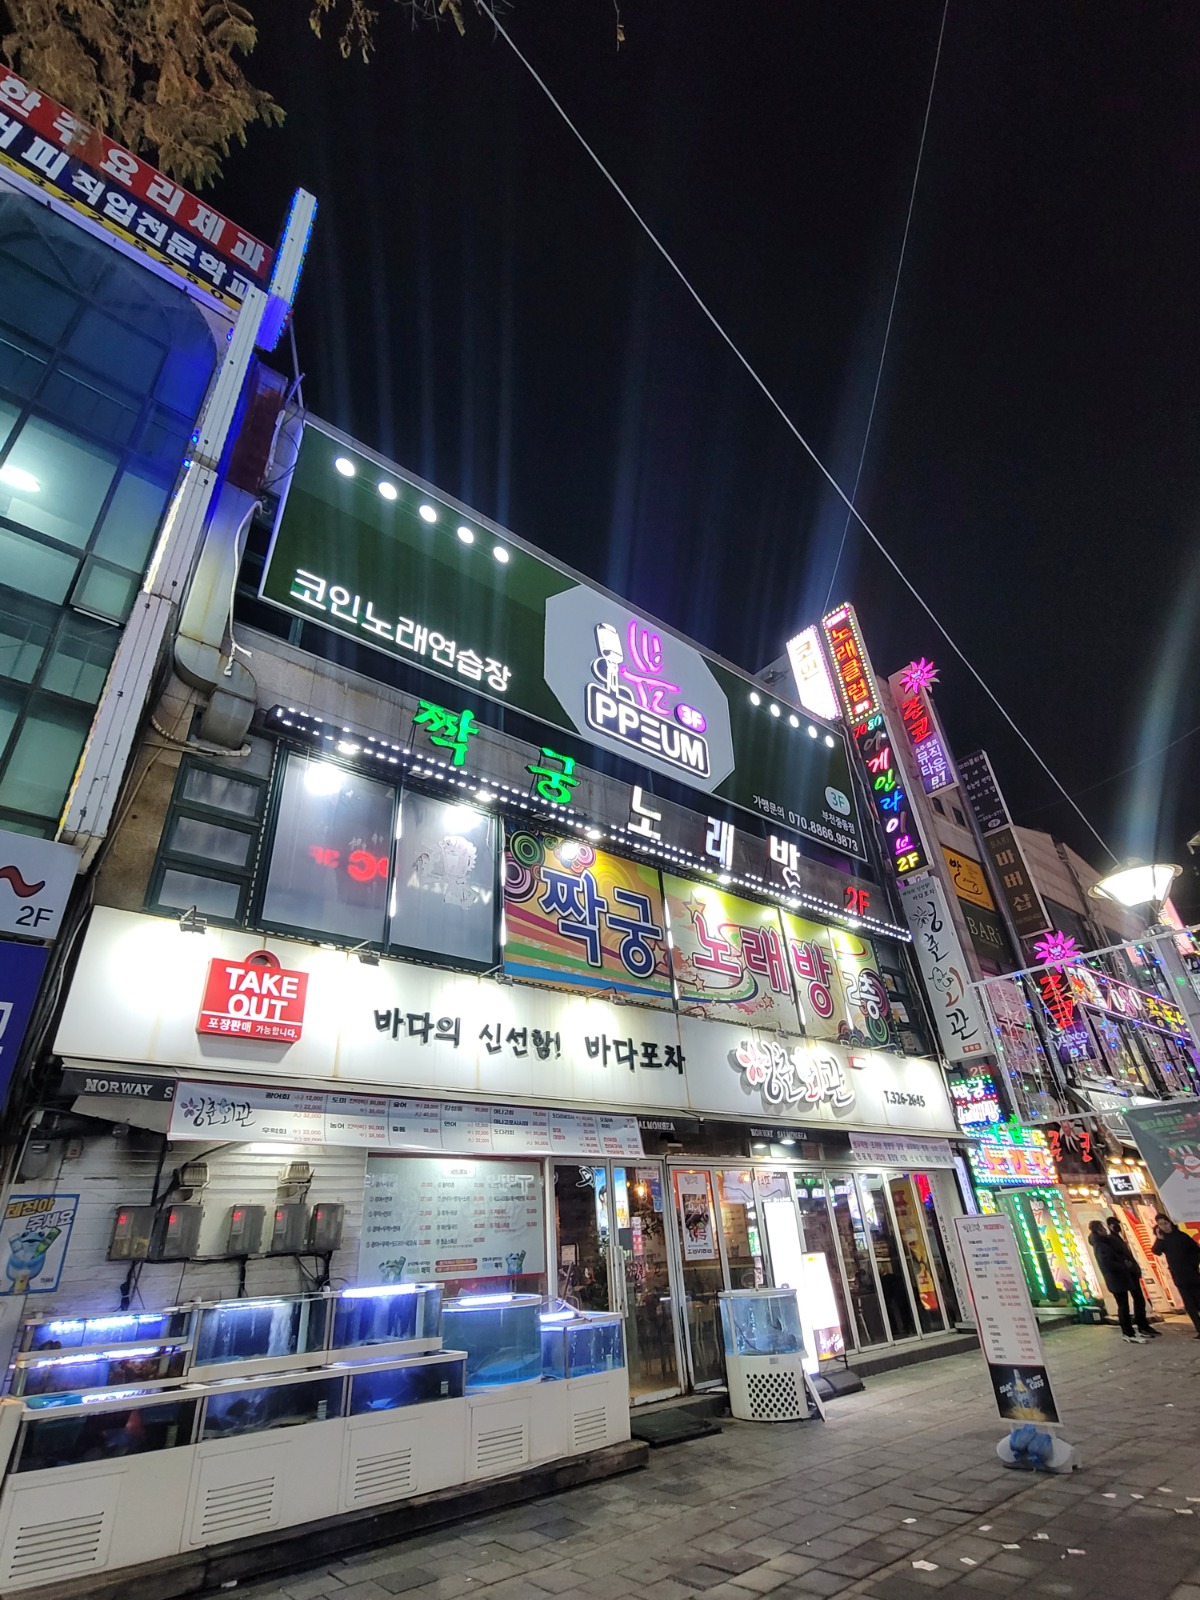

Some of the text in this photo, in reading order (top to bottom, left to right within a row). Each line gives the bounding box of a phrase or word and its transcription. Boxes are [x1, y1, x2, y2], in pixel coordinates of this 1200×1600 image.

[290, 568, 512, 692] 코인노래연습장
[831, 626, 869, 702] 노래클럽
[596, 692, 706, 770] PPEUM
[681, 709, 704, 728] 3F
[931, 770, 947, 785] B1
[831, 792, 846, 809] 3F
[853, 714, 882, 739] 7080
[896, 852, 919, 872] 2F
[752, 794, 859, 852] 가맹문의 070.8866.9873
[995, 849, 1034, 912] 바버샵
[845, 887, 870, 916] 2F
[15, 905, 54, 928] 2F
[692, 909, 834, 1018] 노래방
[225, 966, 299, 999] TAKE
[227, 993, 289, 1020] OUT
[207, 1017, 298, 1039] 포장판매 가능합니다.
[374, 1007, 461, 1048] 바다의
[585, 1034, 686, 1075] 바다포차
[84, 1078, 153, 1097] NORWAY
[265, 1091, 290, 1100] 광어회
[26, 1209, 75, 1232] 주세요
